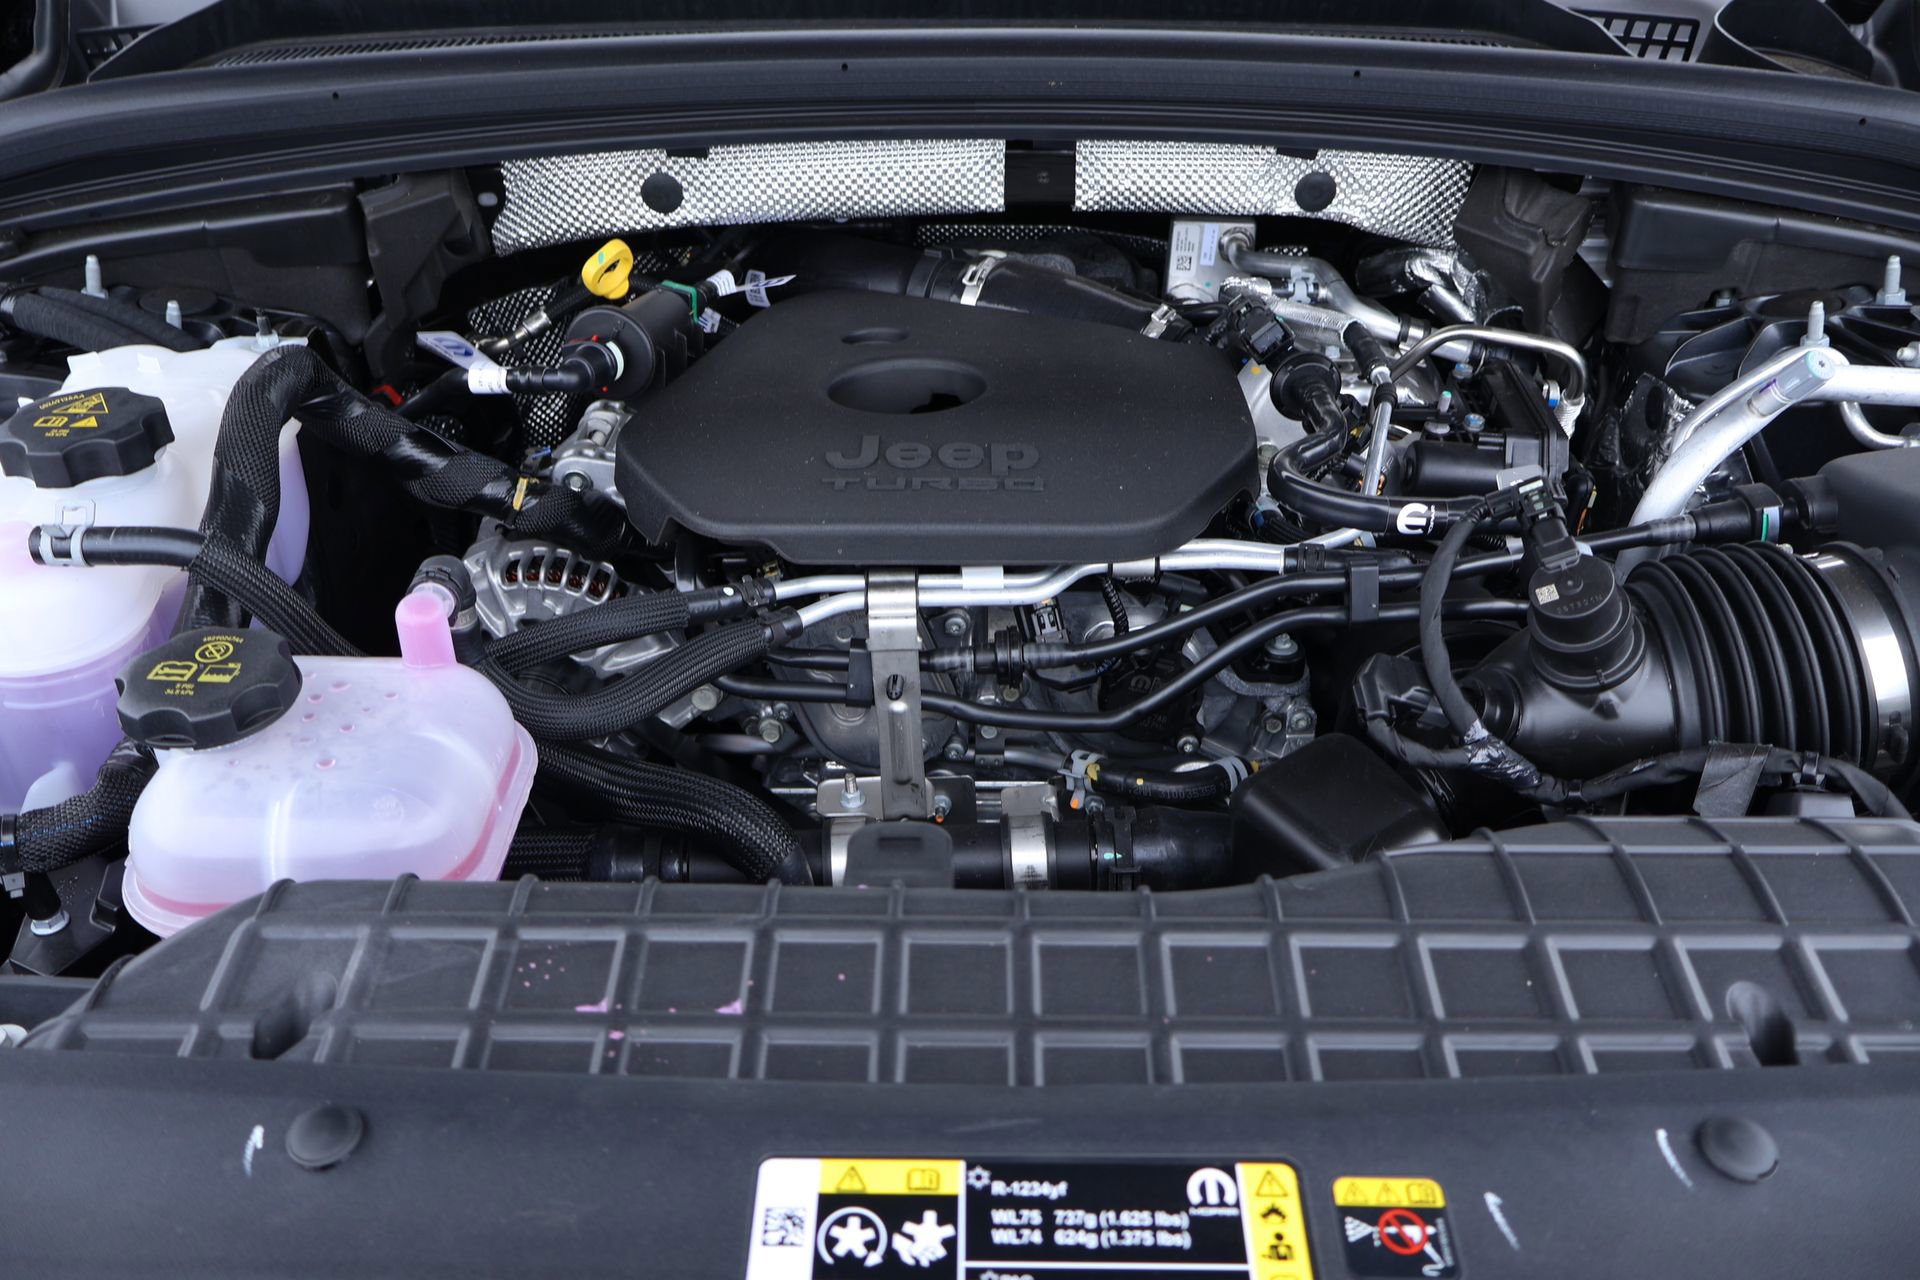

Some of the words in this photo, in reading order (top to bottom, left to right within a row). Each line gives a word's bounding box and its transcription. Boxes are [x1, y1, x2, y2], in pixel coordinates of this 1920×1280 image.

[824, 434, 1041, 476] Jeep
[822, 476, 1045, 492] TURBO
[990, 1179, 1068, 1201] R-1234yf
[990, 1208, 1043, 1226] WL75
[1154, 1209, 1190, 1231] lbs)
[990, 1228, 1043, 1246] WL74
[1156, 1229, 1192, 1251] lbs)
